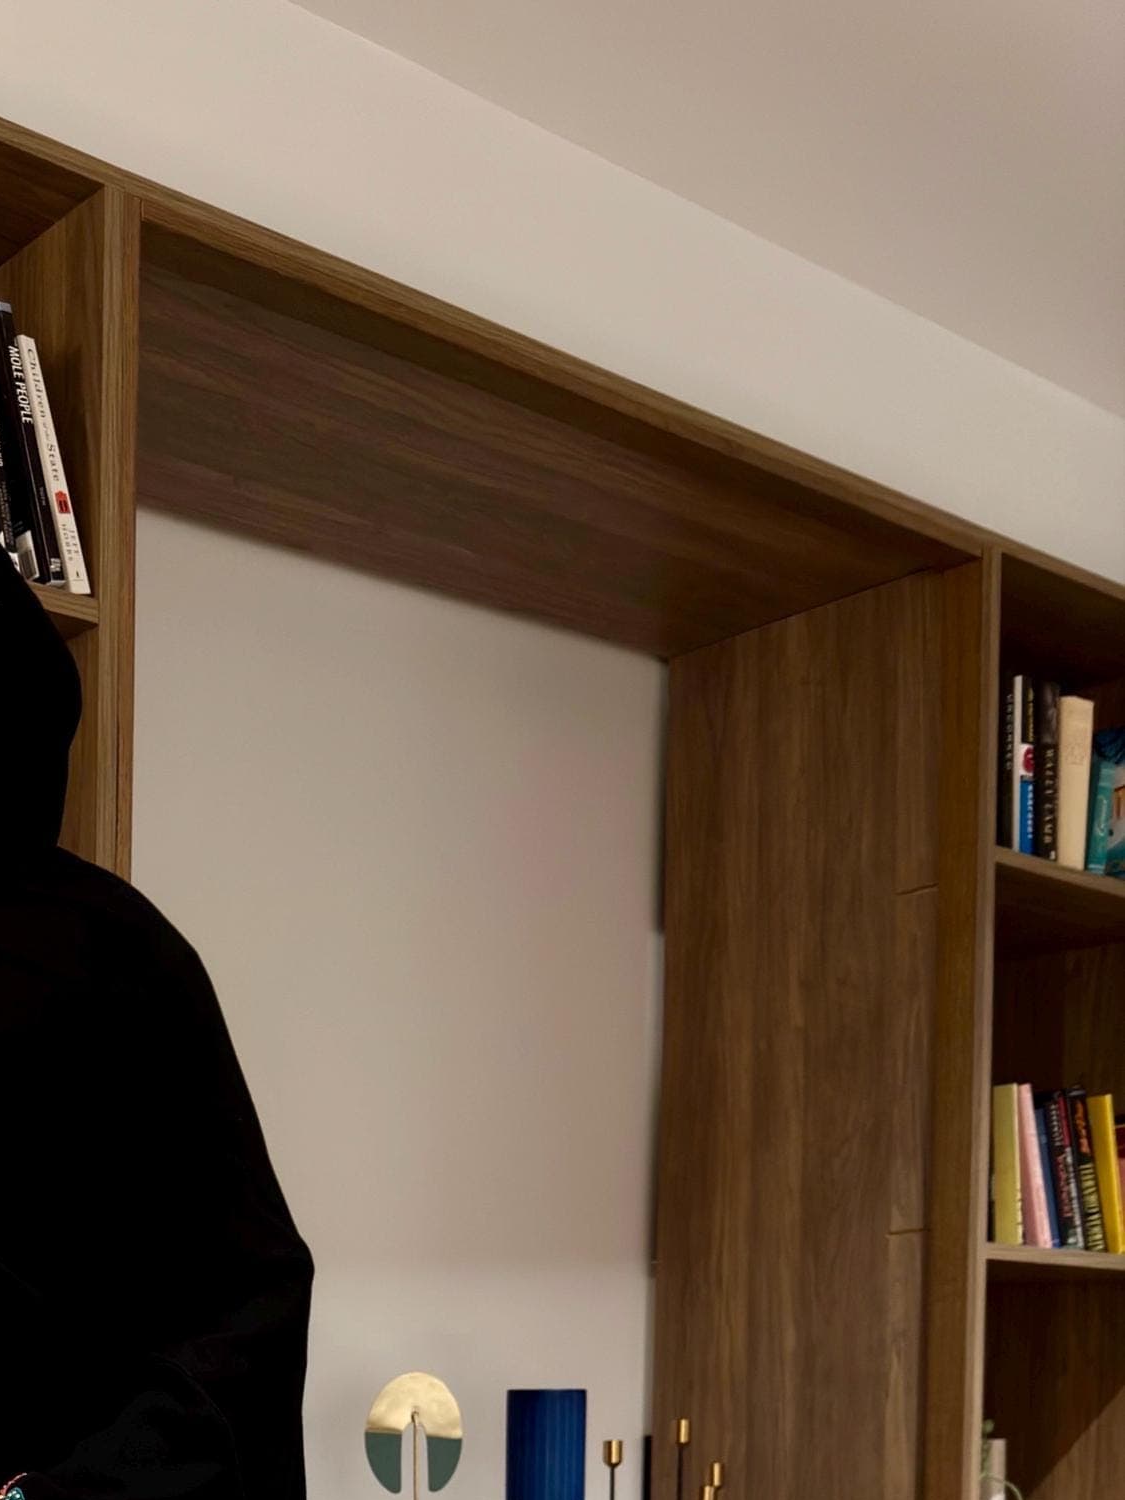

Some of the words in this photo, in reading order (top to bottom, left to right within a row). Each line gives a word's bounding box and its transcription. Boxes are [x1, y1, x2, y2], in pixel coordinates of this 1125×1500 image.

[8, 345, 24, 379] MOLE
[26, 348, 48, 418] Children
[14, 381, 33, 424] PEOPLE
